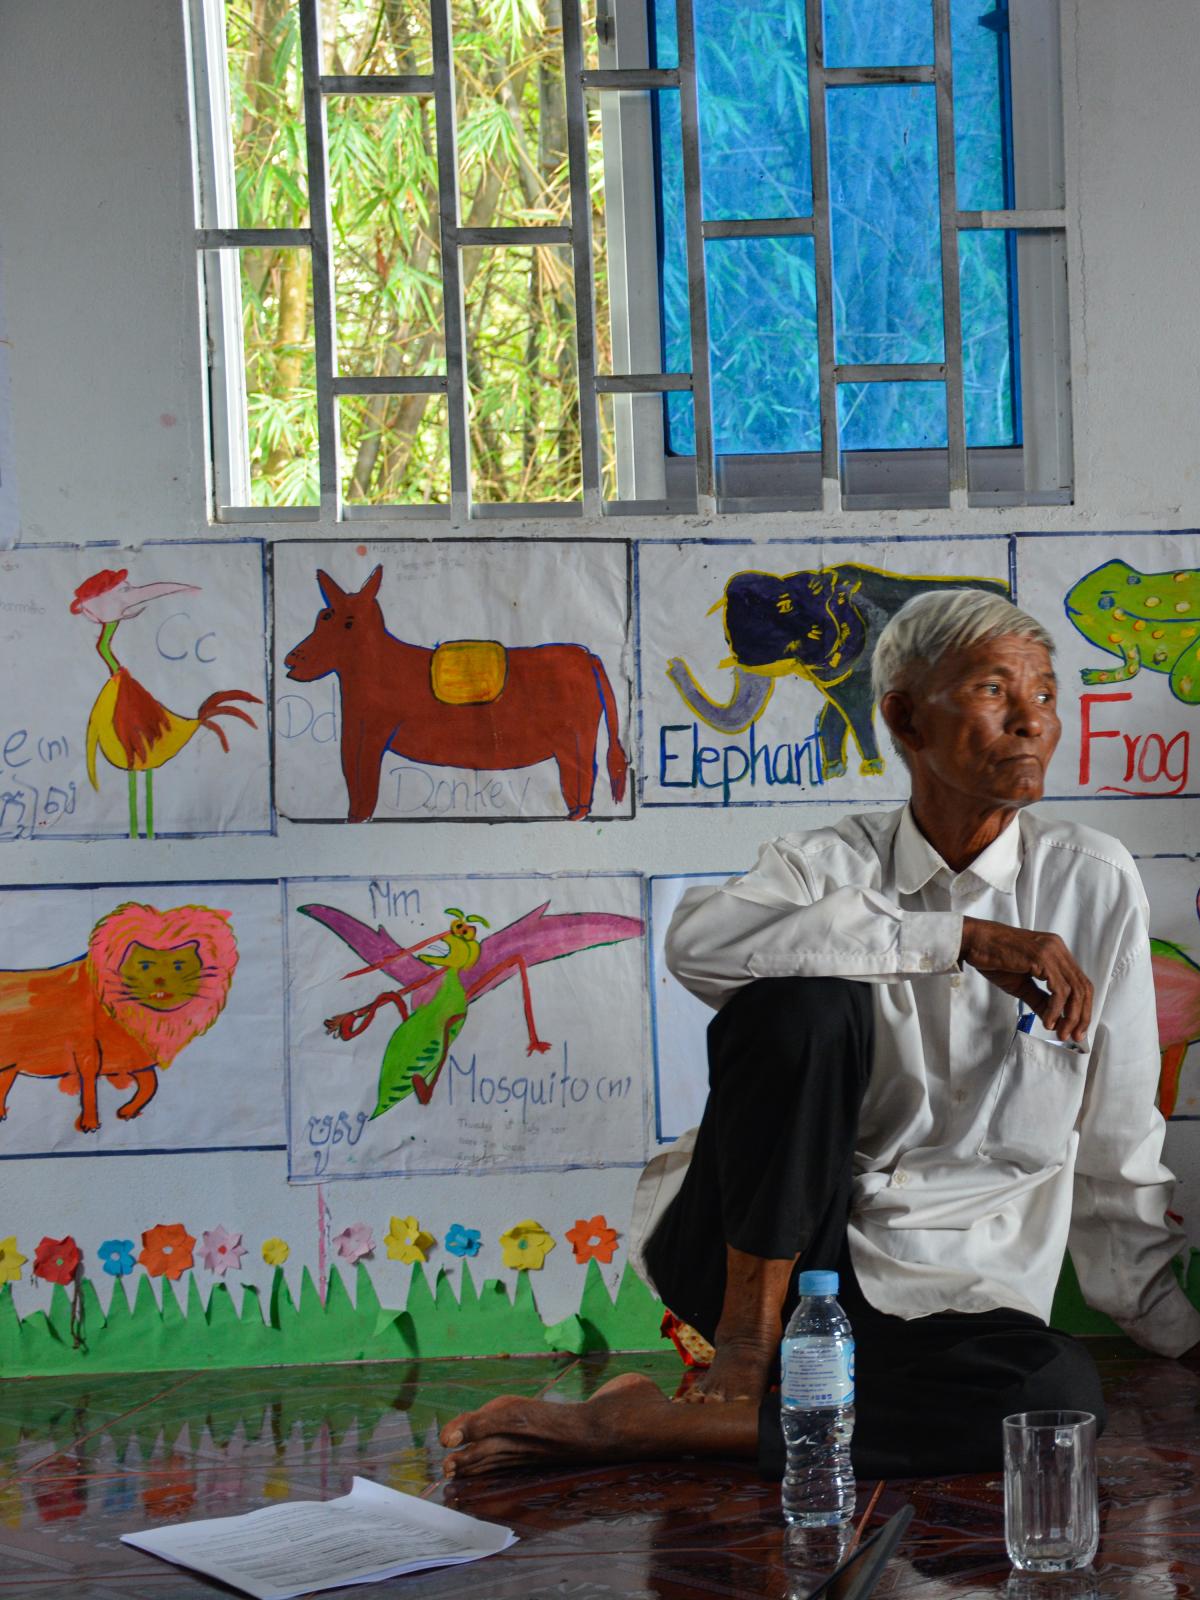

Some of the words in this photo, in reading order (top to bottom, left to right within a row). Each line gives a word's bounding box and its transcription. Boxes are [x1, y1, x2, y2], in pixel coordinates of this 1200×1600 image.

[156, 612, 217, 663] Cc
[275, 683, 338, 744] Dd
[1078, 692, 1190, 796] Frog
[660, 714, 825, 806] Elephant
[382, 766, 531, 816] Donkey
[369, 881, 420, 918] Mm
[450, 1040, 590, 1124] Mosquito
[597, 1077, 632, 1100] (n)
